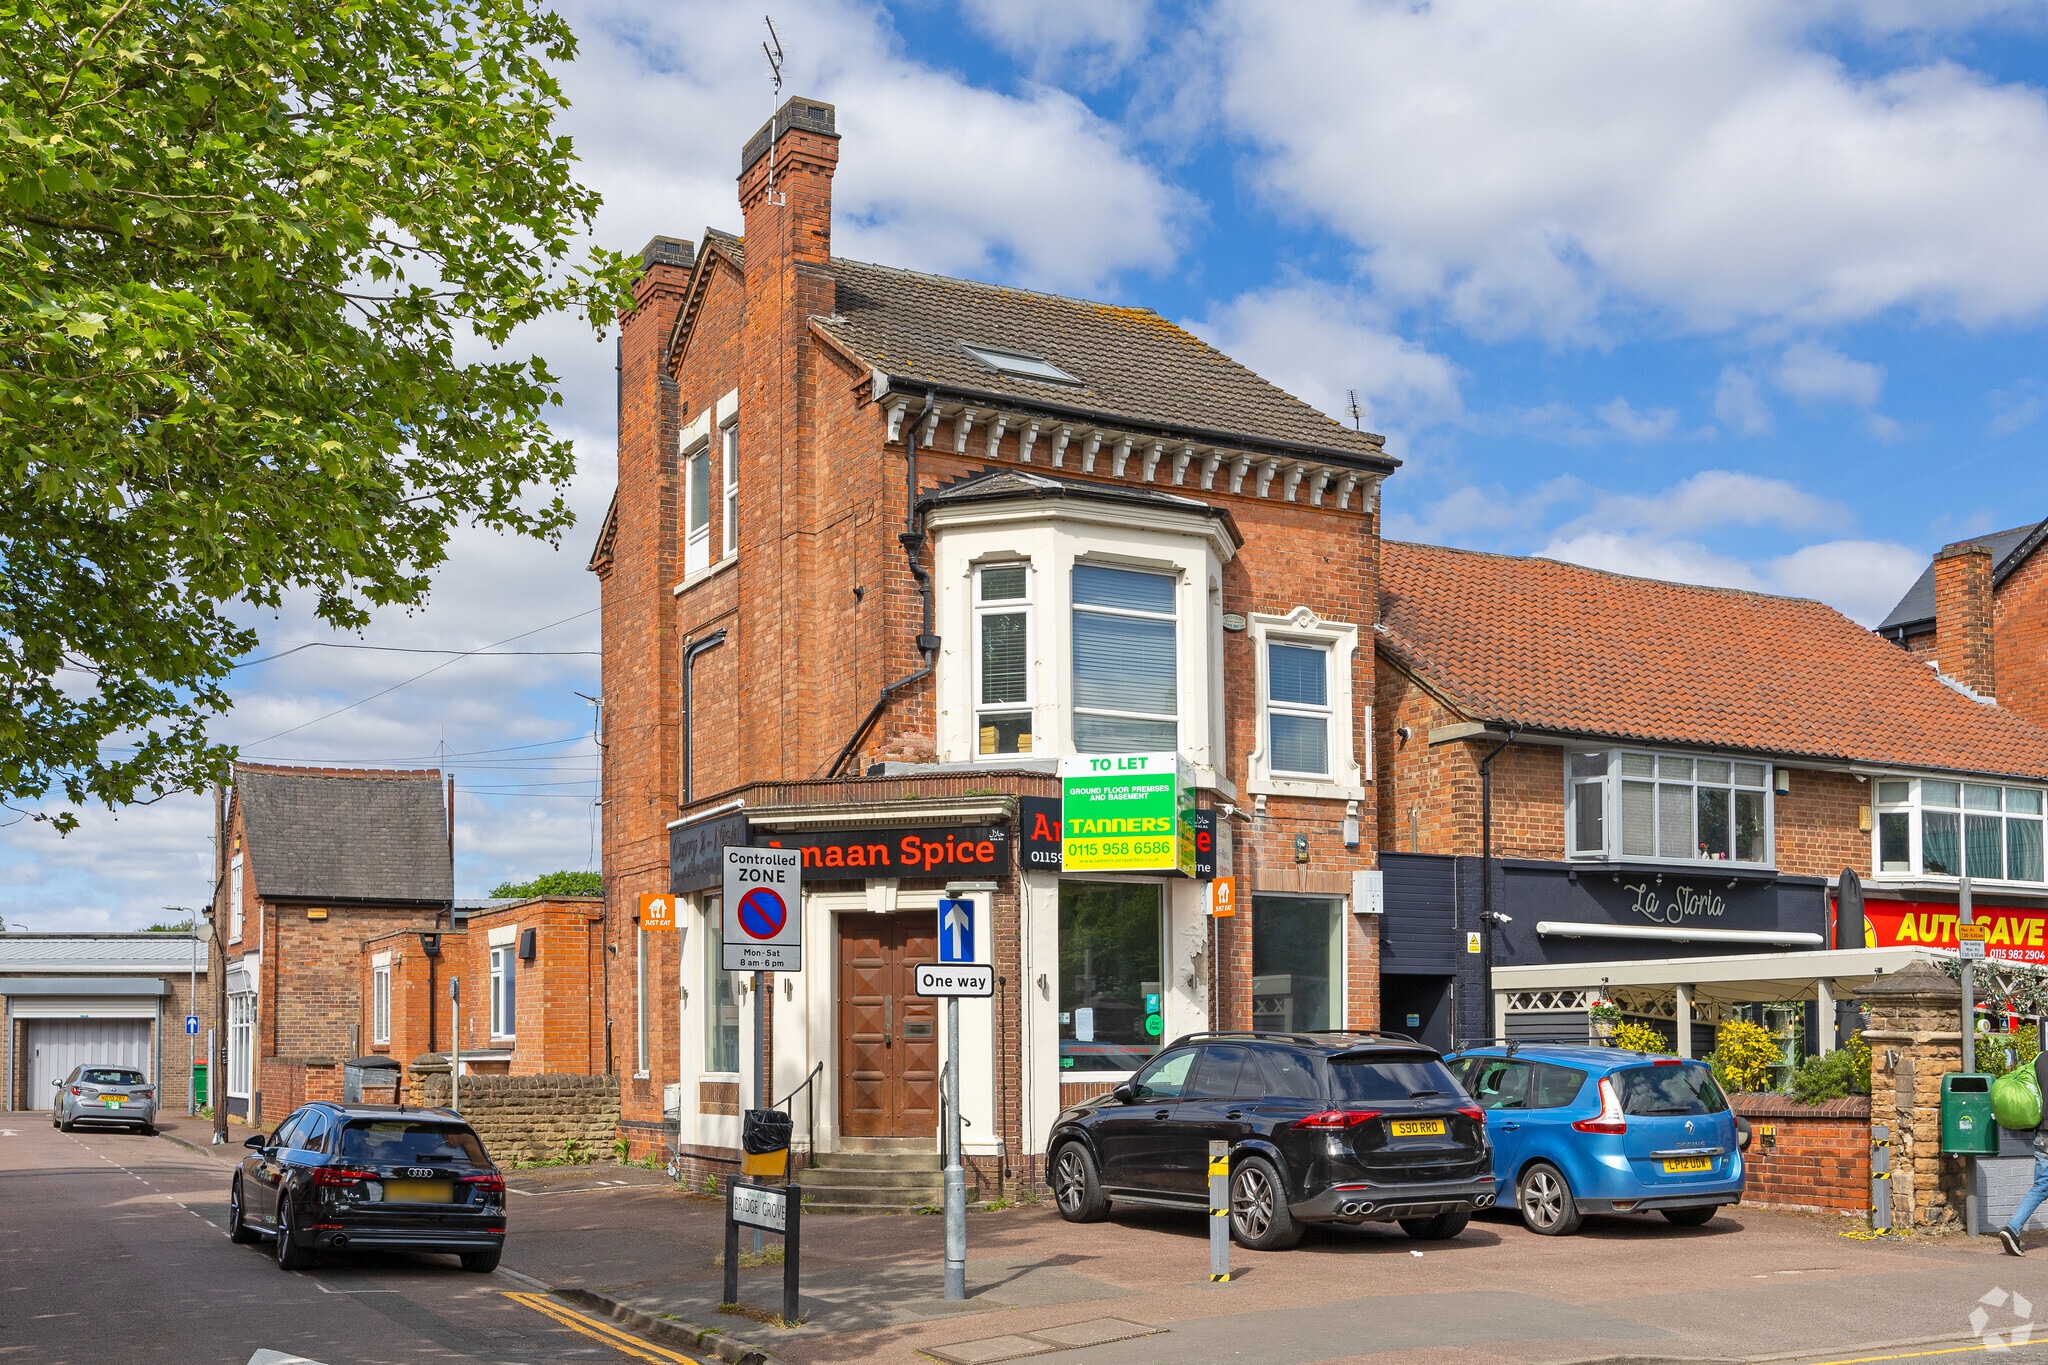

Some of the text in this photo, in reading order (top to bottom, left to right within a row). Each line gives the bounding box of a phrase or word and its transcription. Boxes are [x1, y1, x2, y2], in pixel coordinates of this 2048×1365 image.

[1090, 757, 1148, 771] TO LET
[1070, 785, 1170, 795] GROUND FLOOR PREMISES
[1068, 817, 1171, 834] TANNERS
[769, 835, 995, 872] maan Spice
[1068, 841, 1171, 856] 0115 958 6586
[729, 852, 797, 866] Controlled
[739, 868, 786, 883] ZONE
[1624, 883, 1726, 924] La Storia
[644, 919, 660, 927] JUST
[1990, 948, 2045, 960] 0115 982 2904
[923, 973, 986, 990] One way
[1069, 1045, 1107, 1053] Restaurant
[1117, 1045, 1151, 1054] Takeaway
[1399, 1121, 1438, 1134] S90 RRO
[734, 1196, 786, 1220] BRIDGE GROVE
